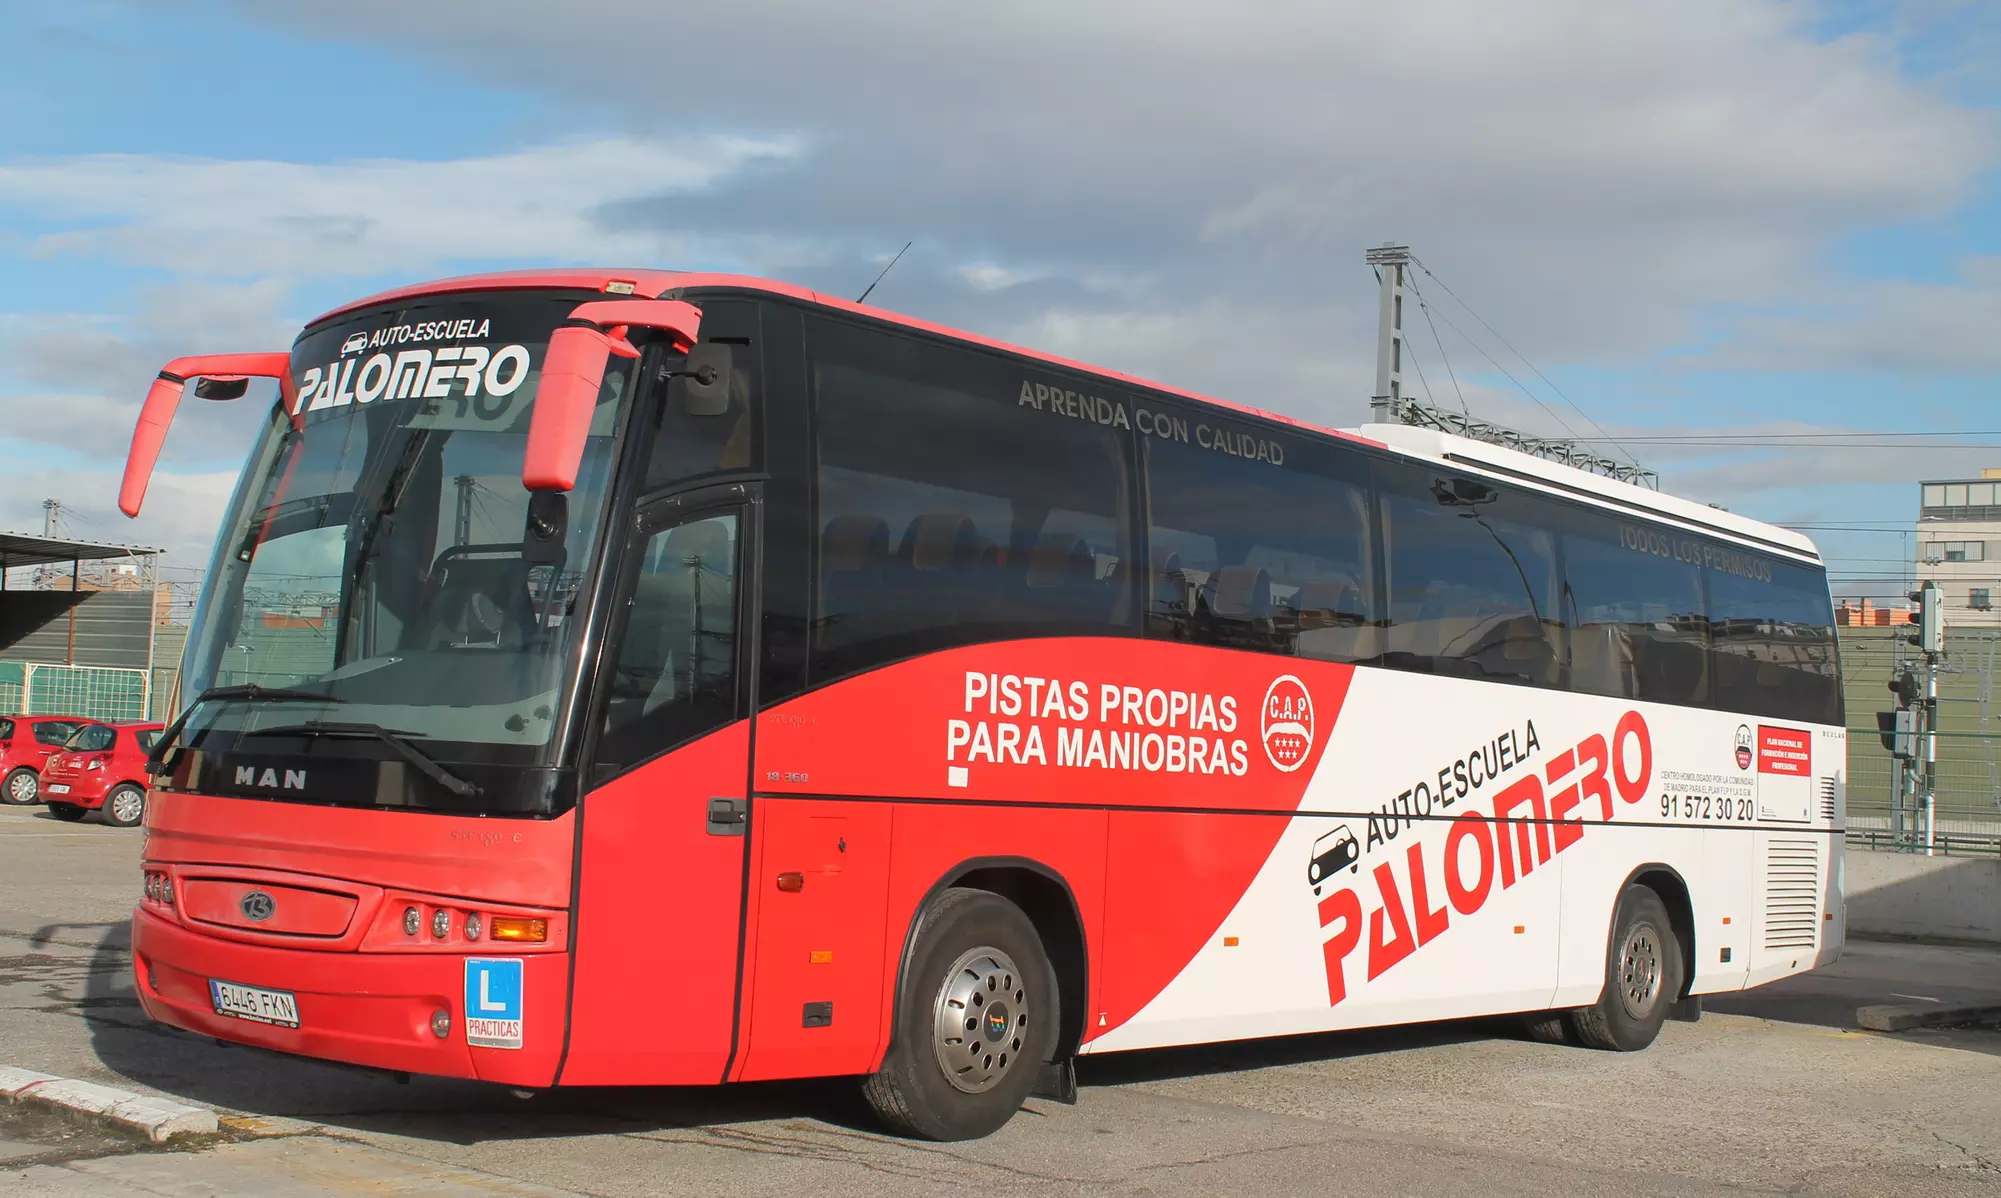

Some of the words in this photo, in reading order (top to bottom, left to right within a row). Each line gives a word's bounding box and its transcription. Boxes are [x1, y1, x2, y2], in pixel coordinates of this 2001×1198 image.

[368, 319, 490, 348] AUTO-ESCUELA
[292, 345, 531, 416] PALOMERO
[1018, 379, 1131, 431] APRENDA
[1136, 408, 1189, 443] CON
[1196, 424, 1285, 466] CALIDAD
[1618, 523, 1670, 558] TODOS
[1673, 539, 1702, 566] LOS
[1704, 545, 1772, 583] PERMISOS
[965, 671, 1089, 721] PISTAS
[1100, 684, 1237, 733] PROPIAS
[947, 719, 1047, 765] PARA
[1057, 727, 1248, 776] MANIOBRAS
[235, 766, 307, 789] MAN
[1367, 719, 1541, 854] AUTO-ESCUELA
[1660, 771, 1680, 780] CENTRO
[1681, 772, 1712, 782] HOMOLOGADO
[1713, 775, 1722, 783] POR
[1723, 776, 1729, 784] LA
[1664, 783, 1671, 791] DE
[1671, 783, 1689, 792] MADRID
[1689, 784, 1701, 793] PARA
[1702, 785, 1708, 793] EL
[1708, 786, 1720, 794] PLAN
[1661, 793, 1677, 817] 91
[1685, 795, 1711, 819] 572
[1716, 797, 1732, 820] 30
[1737, 798, 1754, 821] 20
[1317, 710, 1653, 1009] PALOMERO
[221, 986, 258, 1013] 6446
[261, 993, 294, 1018] FKN
[480, 970, 507, 1011] L
[469, 1019, 519, 1037] PRACTICAS
